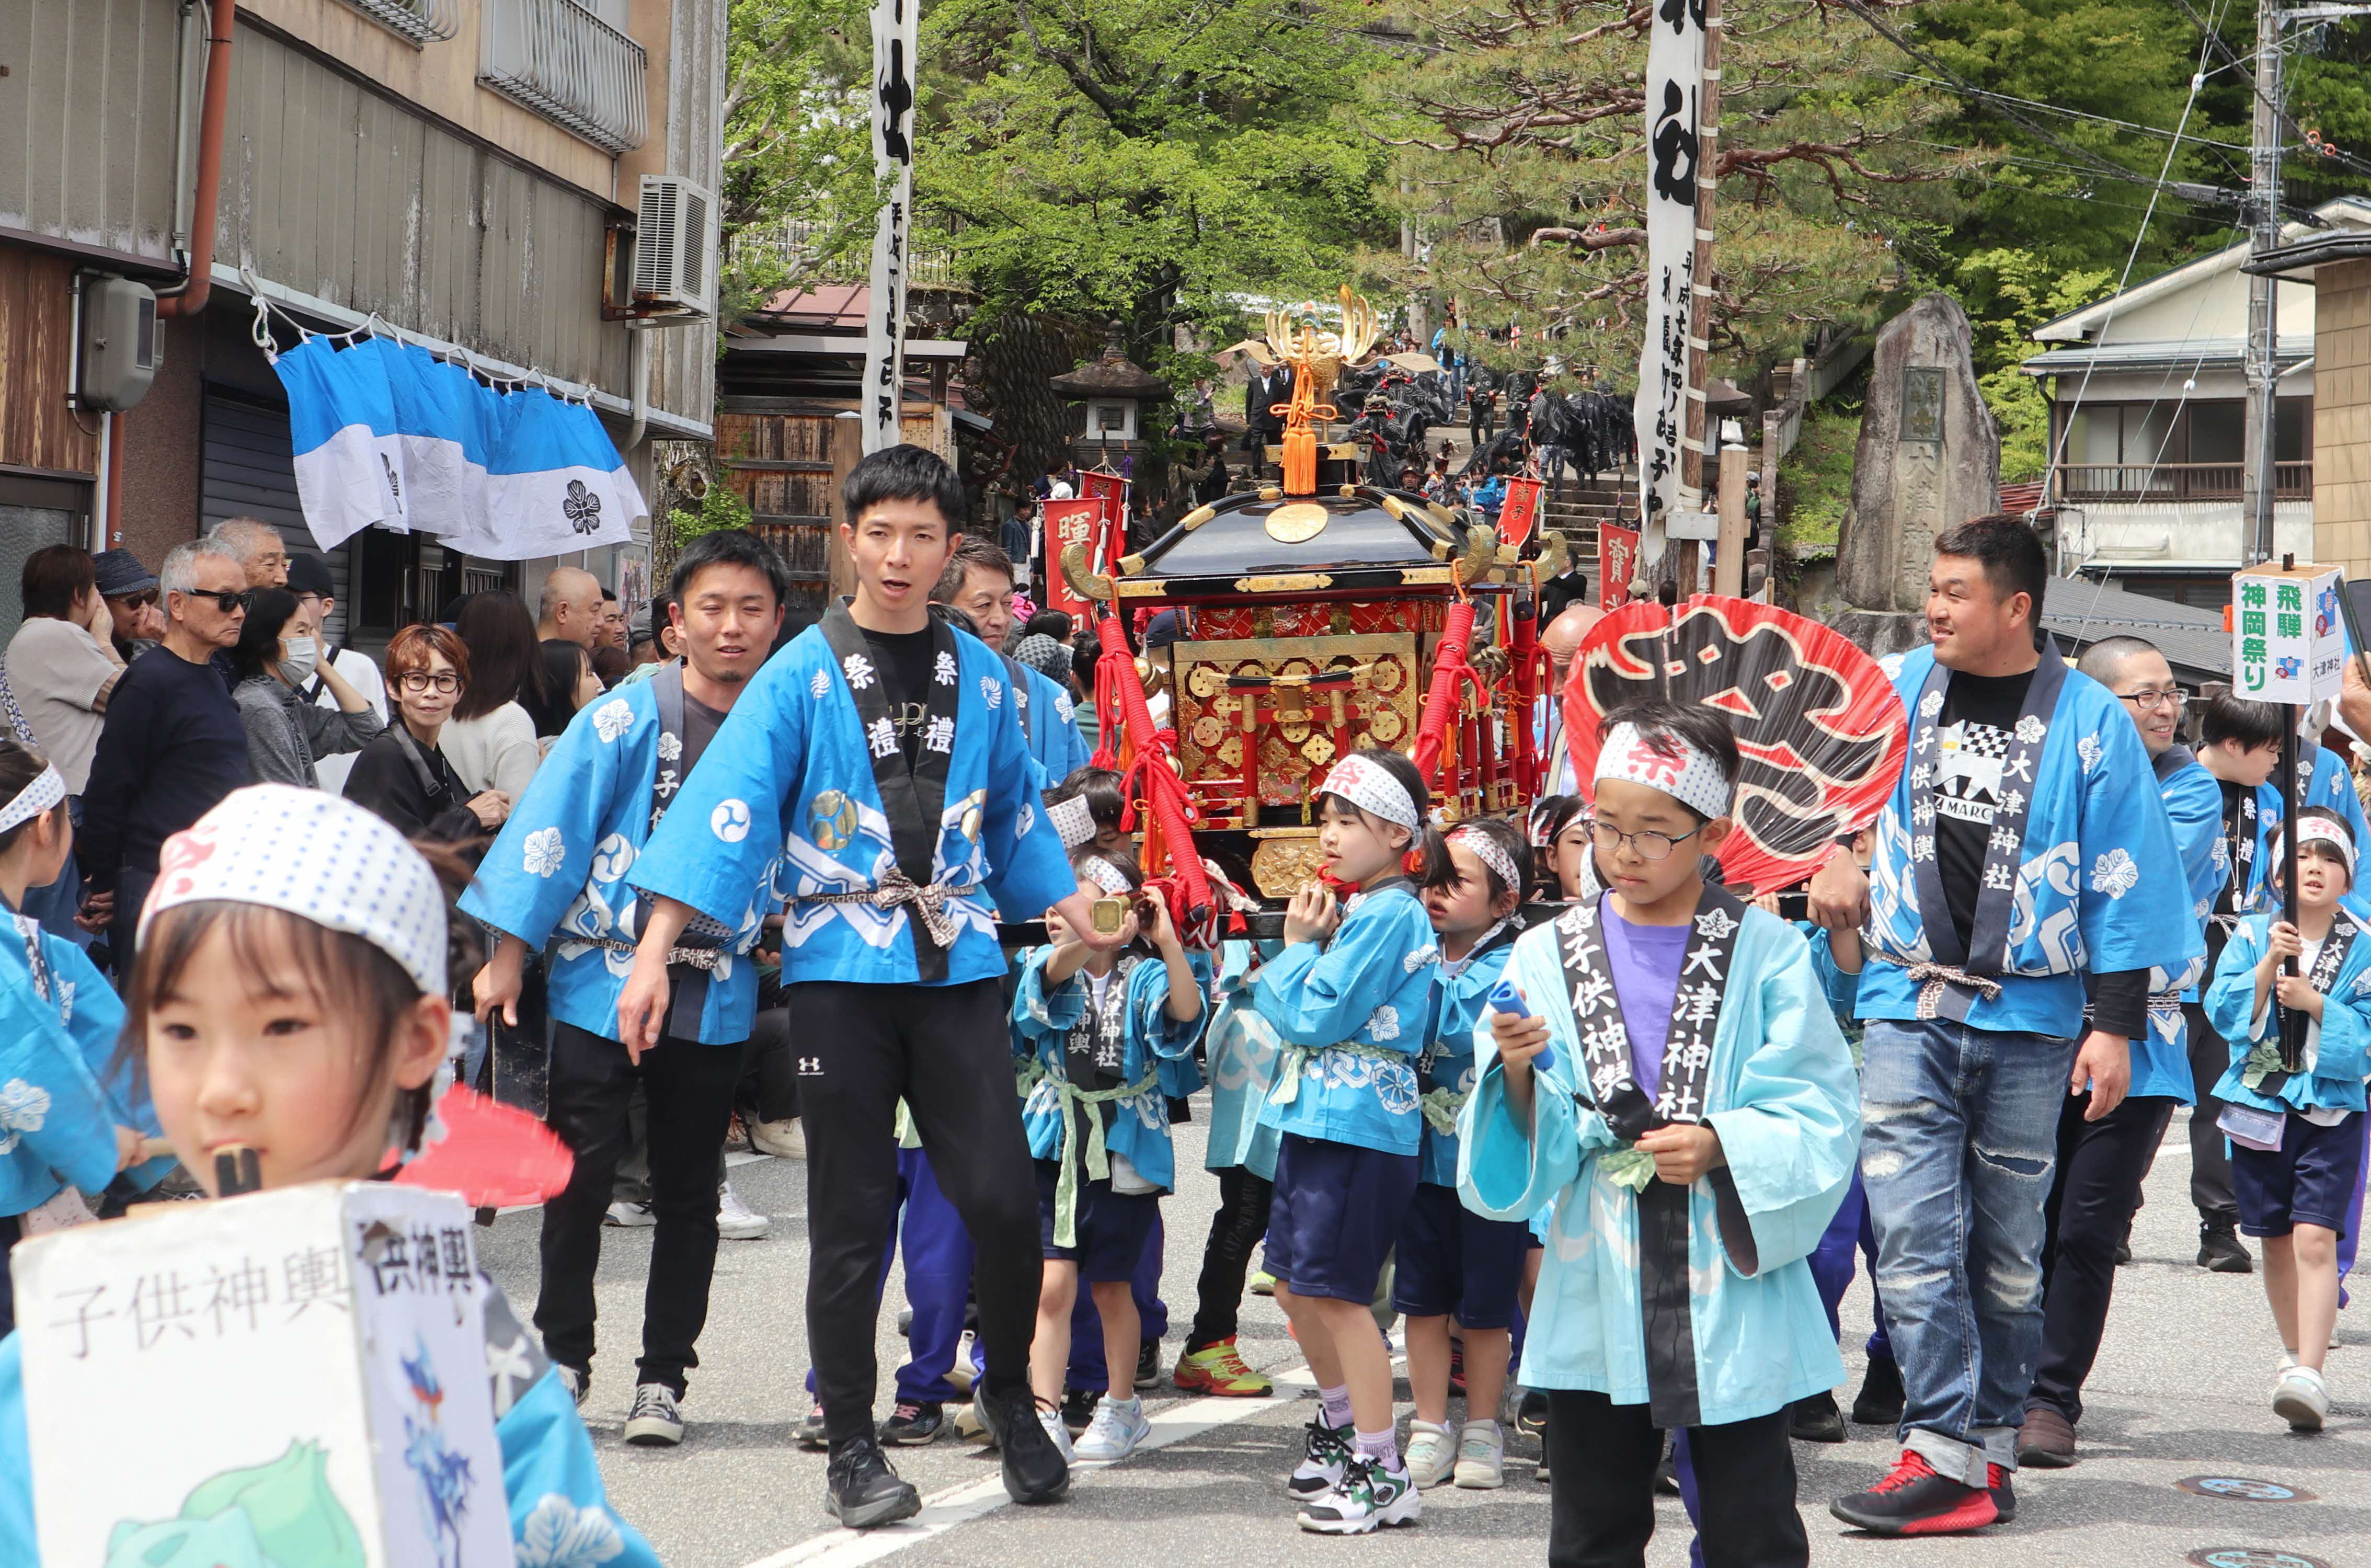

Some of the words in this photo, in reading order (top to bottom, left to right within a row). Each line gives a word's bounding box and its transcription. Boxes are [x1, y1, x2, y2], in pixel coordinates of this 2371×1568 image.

[2241, 582, 2267, 691] 神岡祭り
[2313, 655, 2341, 680] 大津神社
[1326, 761, 1365, 795] 祭
[1910, 726, 1935, 863] 子供神輿
[1983, 749, 2033, 891] 大津神社
[1095, 979, 1125, 1068] 大津神社
[1564, 934, 1633, 1103] 子供神輿
[1654, 942, 1724, 1122] 大津神社
[48, 1246, 350, 1361] 子供神輿
[356, 1220, 472, 1296] 供神輿
